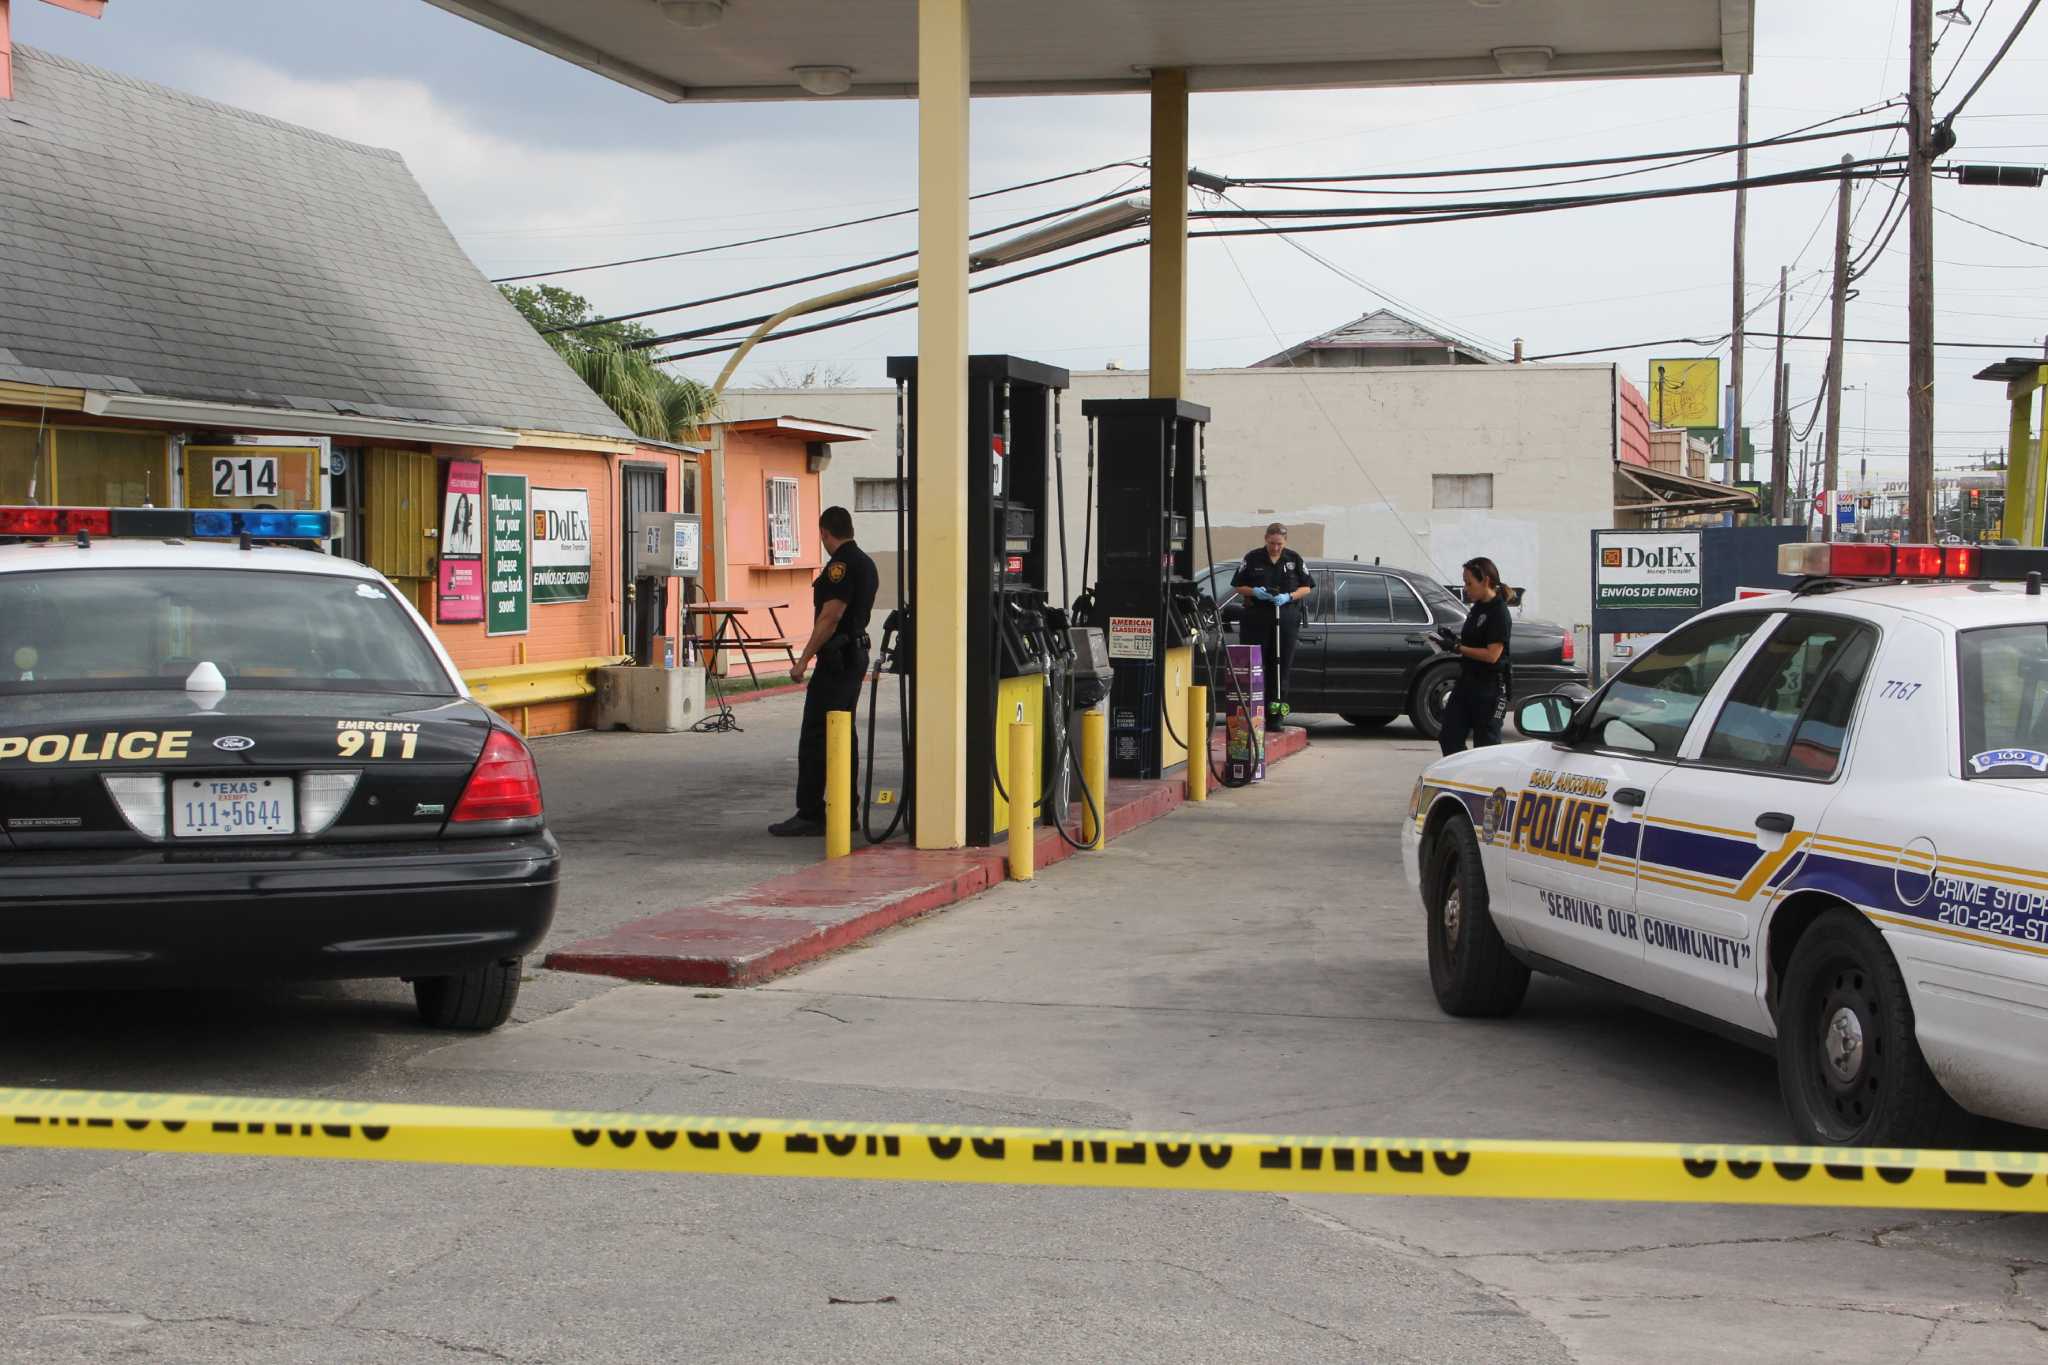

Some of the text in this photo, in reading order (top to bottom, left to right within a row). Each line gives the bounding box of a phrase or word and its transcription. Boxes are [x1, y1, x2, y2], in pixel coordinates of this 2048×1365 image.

[215, 459, 276, 495] 214
[491, 494, 522, 515] Thank you
[496, 514, 520, 535] for your
[548, 510, 588, 541] DolEx
[494, 536, 522, 557] business,
[497, 556, 517, 576] please
[1626, 547, 1697, 568] DolEx
[491, 575, 523, 593] come back
[566, 571, 589, 585] DINERO
[1601, 586, 1698, 597] ENVÍOS DE DINERO
[498, 596, 515, 613] soon!
[1136, 640, 1152, 649] FREE
[1880, 680, 1923, 701] 7767
[336, 720, 421, 733] EMERGENCY
[0, 730, 192, 763] POLICE
[336, 731, 418, 759] 911
[1998, 752, 2025, 761] 100
[210, 782, 258, 794] TEXAS
[1511, 790, 1609, 867] POLICE
[1933, 878, 1989, 906] CRIME
[1607, 909, 1639, 941] OUR
